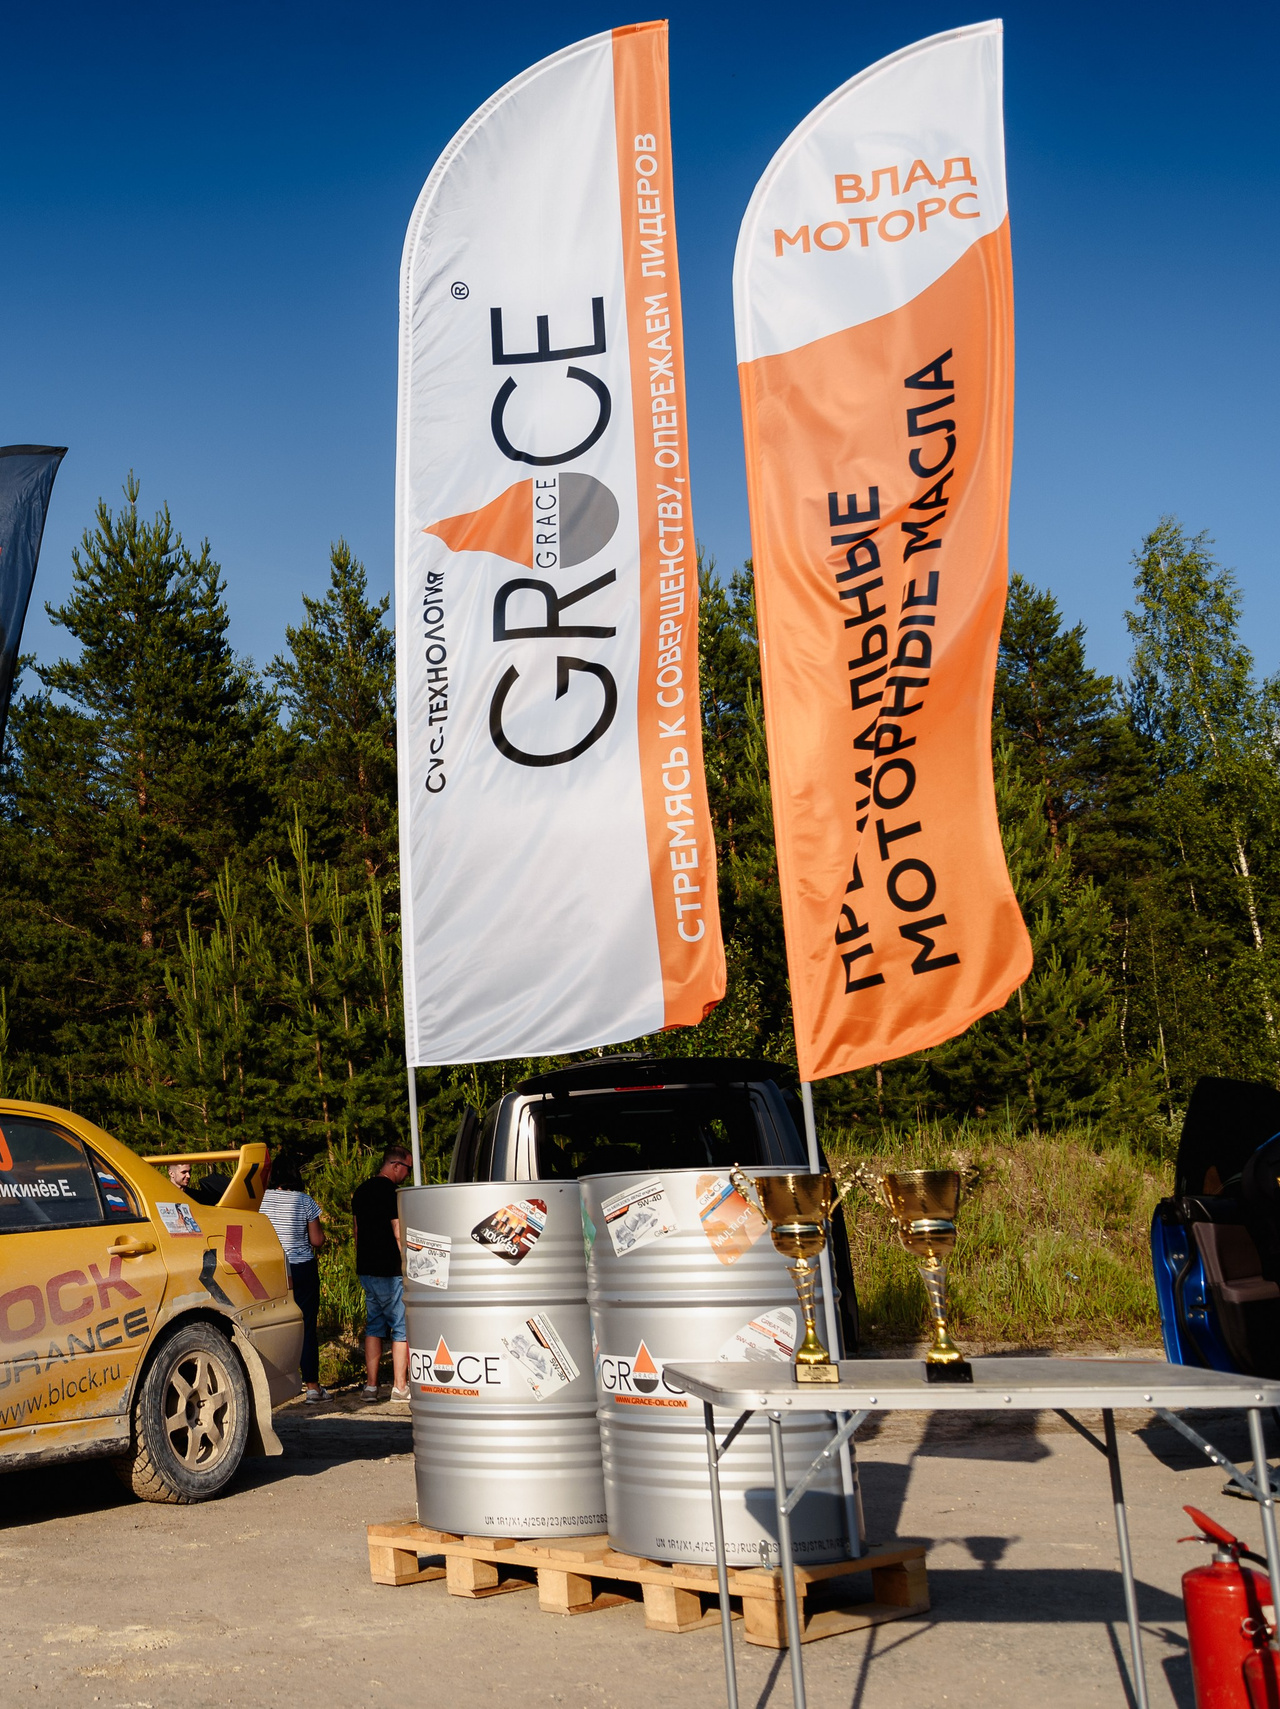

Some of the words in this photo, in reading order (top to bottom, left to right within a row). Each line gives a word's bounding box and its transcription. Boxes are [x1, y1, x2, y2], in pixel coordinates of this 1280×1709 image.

[634, 133, 666, 278] ЛИДЕРОВ
[834, 157, 978, 204] ВЛАД
[774, 192, 980, 257] МОТОРС
[644, 292, 679, 468] ОПЕРЕЖАЕМ
[901, 348, 956, 563] МАСЛА
[536, 478, 557, 569] GRACE
[657, 477, 685, 708] СОВЕРШЕНСТВУ,
[659, 715, 686, 738] К
[873, 571, 961, 975] МОТОРНЫЕ
[659, 746, 706, 942] СТРЕМЯСЬ
[637, 1193, 662, 1208] 5W-40
[713, 1223, 740, 1247] MULTI
[737, 1207, 753, 1226] CVT
[616, 1395, 687, 1408] WWW.GRACE-OIL.COM
[484, 1515, 495, 1525] UN
[655, 1537, 666, 1548] UN
